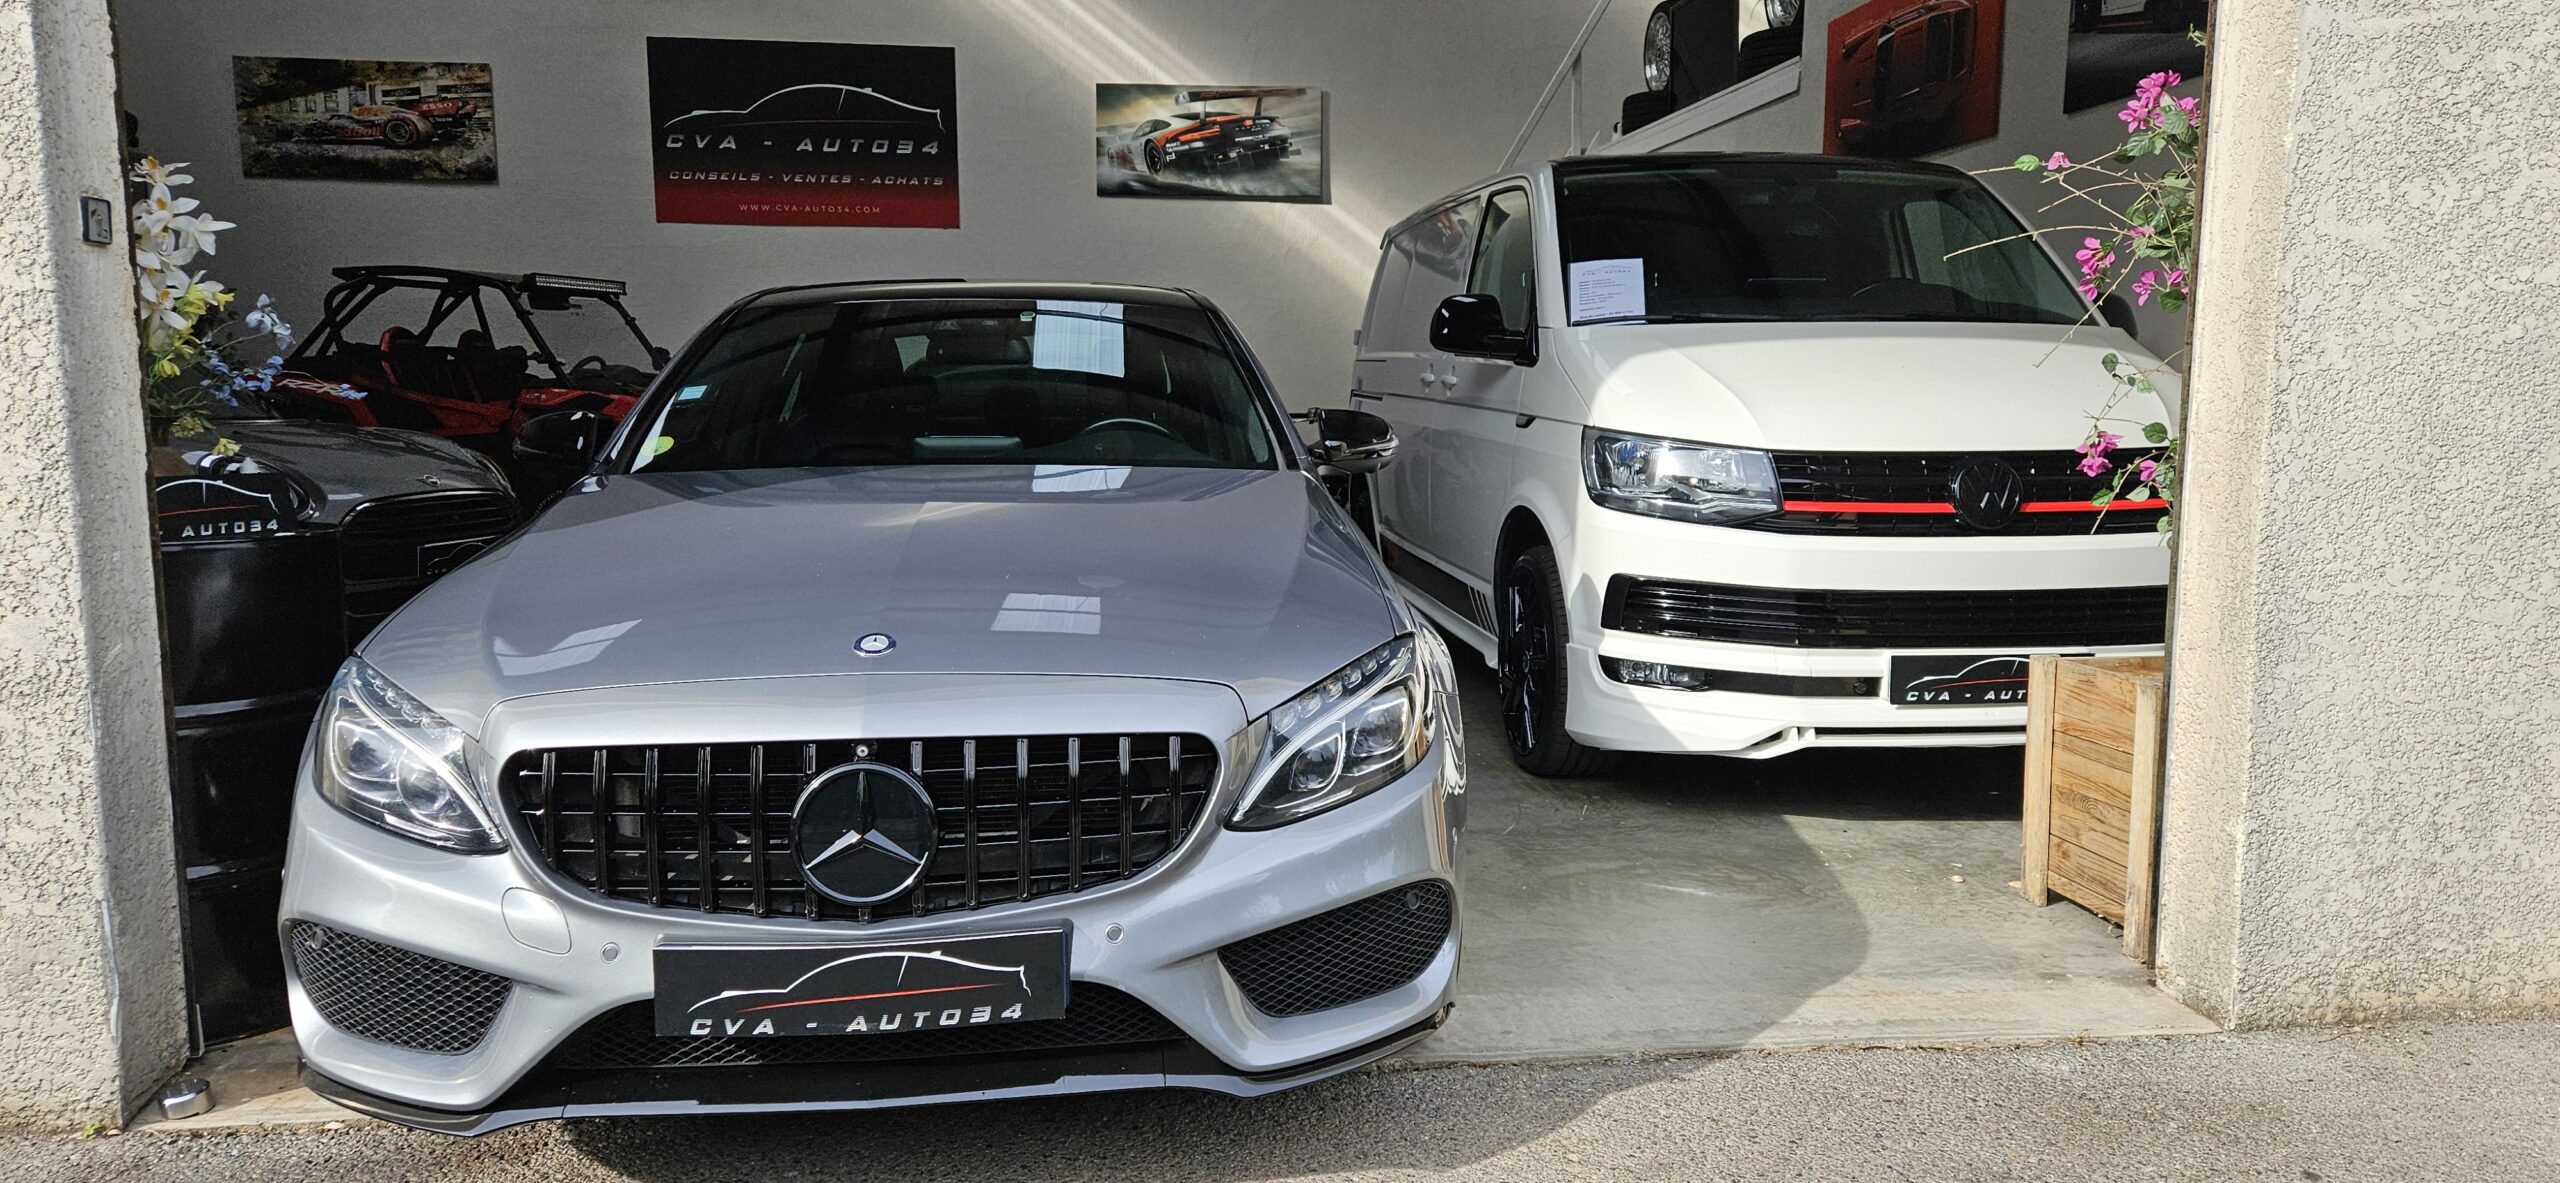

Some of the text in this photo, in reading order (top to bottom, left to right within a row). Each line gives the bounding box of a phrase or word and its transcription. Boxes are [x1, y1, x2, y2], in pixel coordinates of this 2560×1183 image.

[666, 134, 737, 150] CVA
[795, 138, 939, 155] AUTO34
[669, 171, 761, 182] CONSEILS
[782, 174, 852, 184] VENTES
[871, 176, 944, 186] ACHATS
[181, 518, 279, 538] AUTO34
[1905, 690, 1951, 702] CVA
[1983, 689, 2027, 701] AUT
[689, 1018, 775, 1036] CVA
[845, 1003, 1023, 1033] AUTO34
